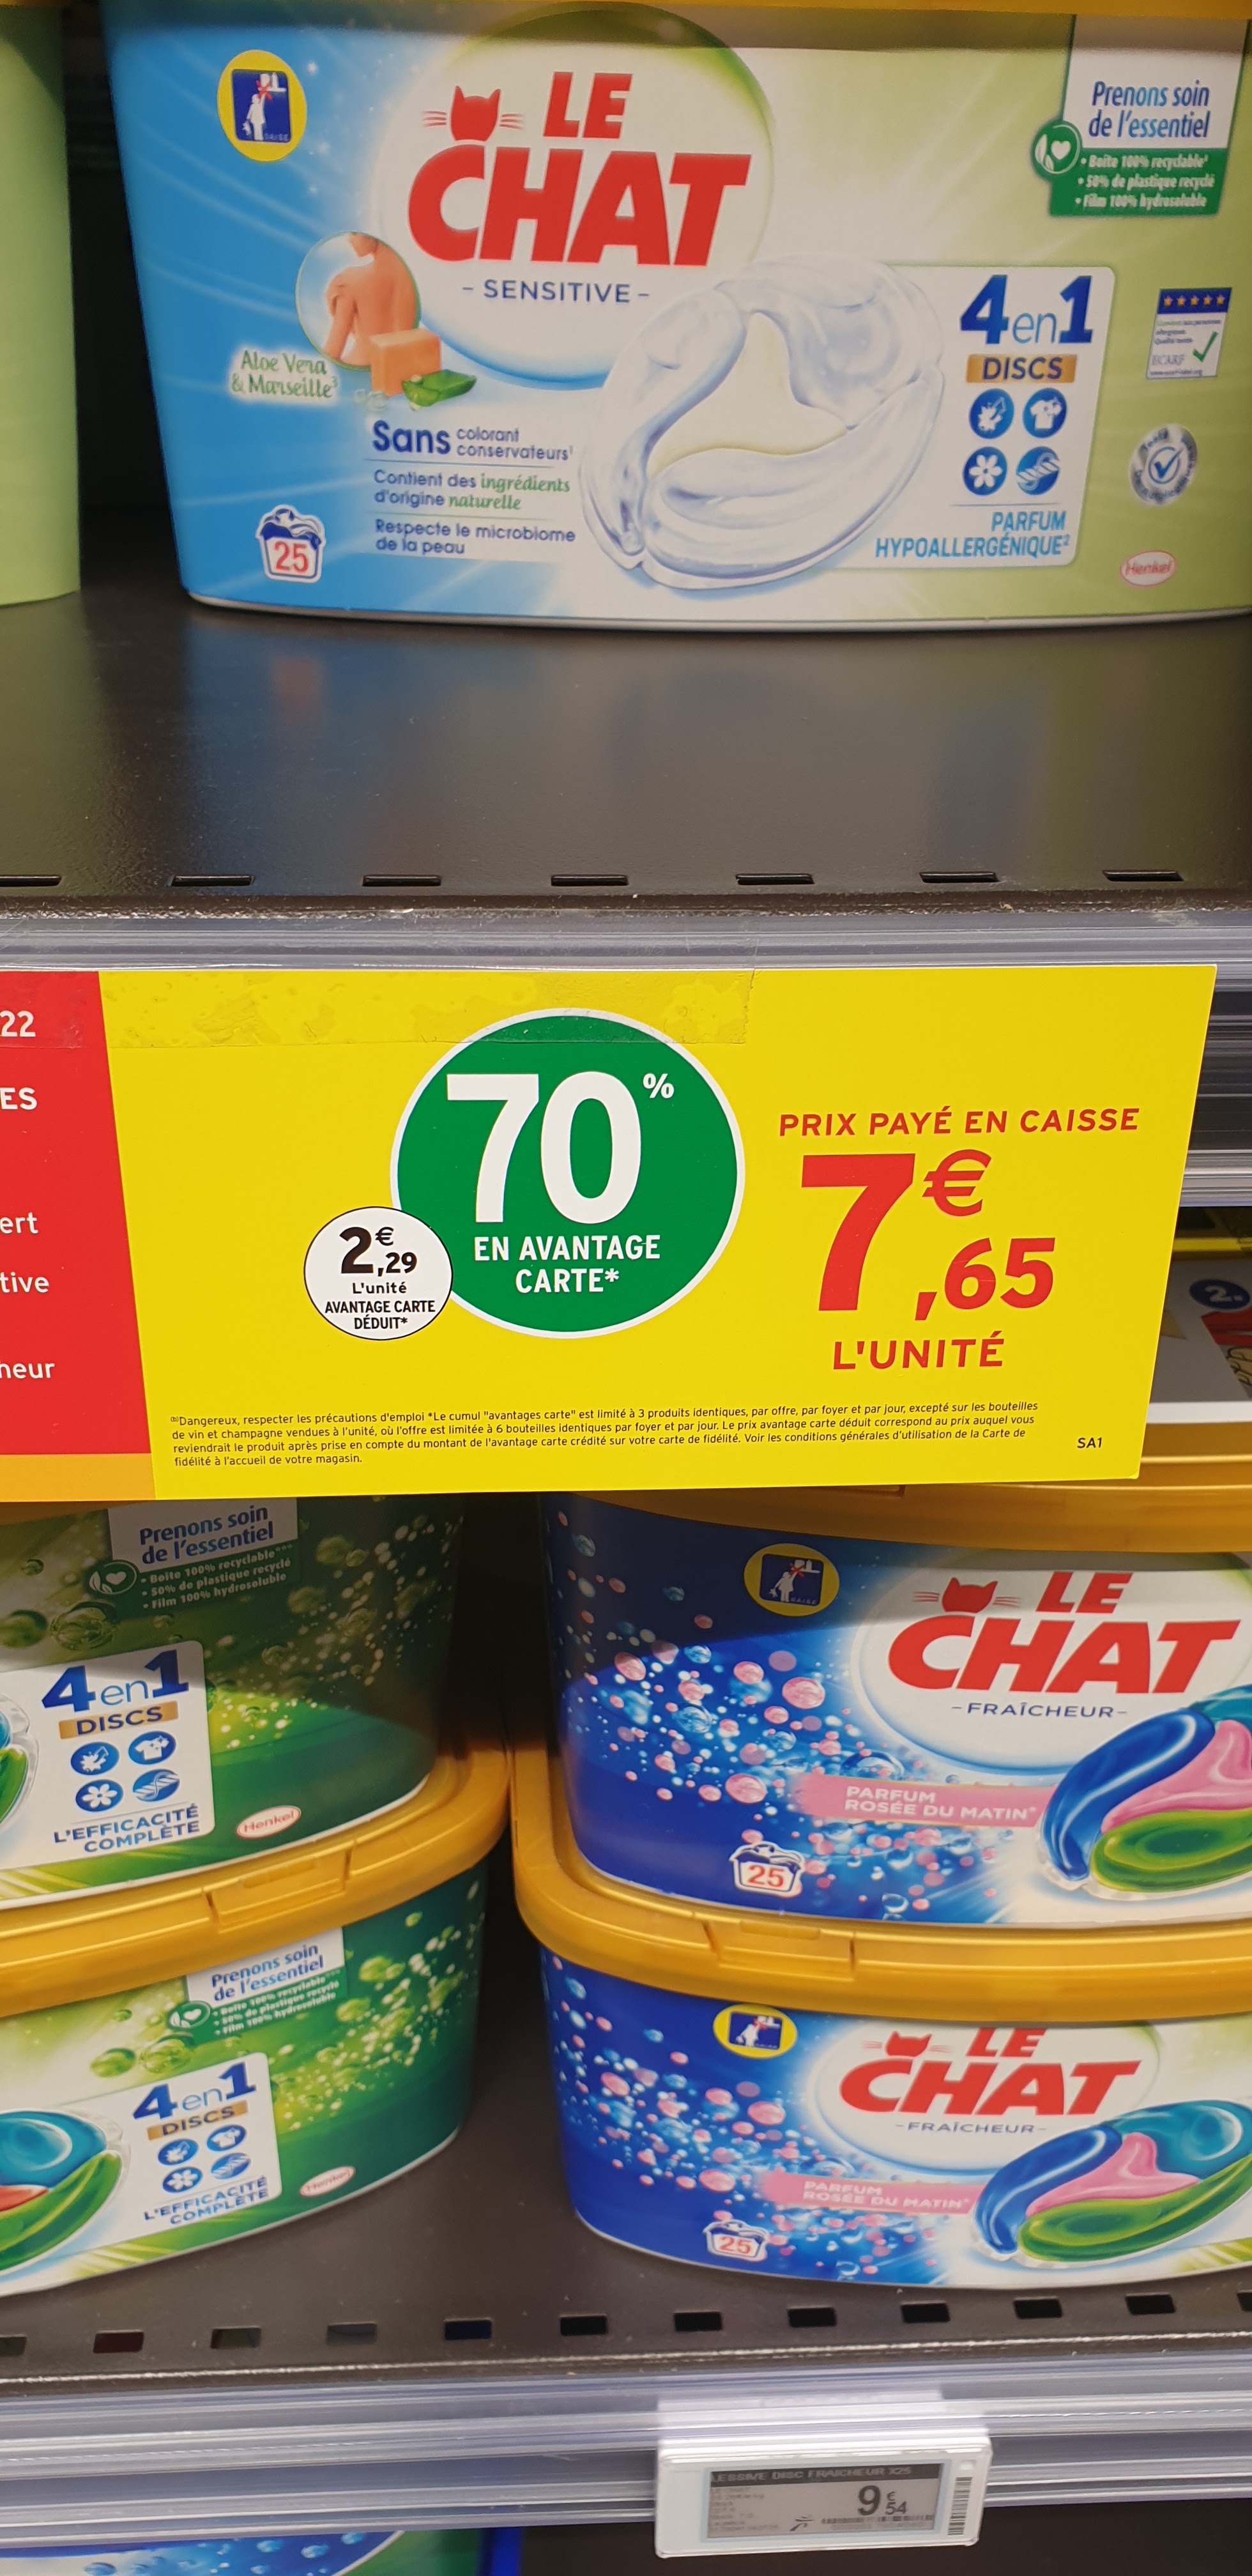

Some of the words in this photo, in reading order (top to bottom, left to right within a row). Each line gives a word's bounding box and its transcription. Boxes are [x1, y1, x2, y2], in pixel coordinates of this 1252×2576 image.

[543, 71, 633, 139] LE
[1092, 80, 1167, 107] Prenons
[1172, 79, 1210, 107] soin
[1088, 109, 1112, 137] de
[1116, 109, 1211, 138] l'essentiel
[408, 144, 752, 266] CHAT
[241, 350, 279, 372] Aloe
[282, 352, 327, 375] Vera
[982, 357, 1063, 380] DISCS
[372, 420, 451, 455] Sans
[457, 426, 519, 443] colorant
[374, 469, 443, 486] Contient
[447, 473, 477, 488] des
[480, 471, 570, 493] ingrédients
[374, 489, 445, 509] d'origine
[448, 494, 522, 510] naturelle
[375, 518, 451, 540] Respecte
[456, 523, 470, 537] le
[475, 525, 576, 542] microbiome
[991, 510, 1066, 532] PARFUM
[274, 541, 309, 572] 25
[376, 537, 397, 551] de
[402, 537, 417, 552] la
[422, 542, 465, 555] peau
[779, 1114, 857, 1137] PRIX
[869, 1105, 952, 1136] PAYÉ
[965, 1110, 1007, 1133] EN
[1019, 1108, 1140, 1133] CAISSE
[448, 1071, 641, 1224] 70
[475, 1237, 509, 1261] EN
[519, 1235, 660, 1261] AVANTAGE
[352, 1282, 407, 1295] L'unité
[324, 1300, 391, 1314] AVANTAGE
[394, 1299, 436, 1313] CARTE
[832, 1331, 1005, 1370] L'UNITÉ
[243, 1414, 294, 1426] respecter
[297, 1414, 312, 1423] les
[315, 1413, 378, 1425] précautions
[380, 1411, 424, 1423] d'emploi
[449, 1411, 480, 1421] cumul
[484, 1410, 541, 1422] "avantages
[544, 1409, 576, 1420] carte"
[579, 1409, 594, 1419] est
[597, 1408, 627, 1418] limité
[629, 1408, 635, 1418] à
[638, 1409, 645, 1418] 3
[648, 1407, 690, 1420] produits
[693, 1407, 749, 1418] identiques,
[751, 1408, 769, 1418] par
[771, 1406, 798, 1416] offre,
[802, 1407, 819, 1416] par
[821, 1405, 849, 1416] foyer
[851, 1404, 862, 1414] et
[864, 1406, 882, 1416] par
[883, 1404, 906, 1415] jour,
[909, 1402, 949, 1414] excepté
[971, 1402, 986, 1411] les
[988, 1401, 1038, 1411] bouteilles
[172, 1430, 185, 1439] de
[188, 1430, 204, 1439] vin
[207, 1429, 218, 1439] et
[221, 1429, 283, 1440] champagne
[286, 1427, 330, 1437] vendues
[333, 1426, 339, 1436] à
[342, 1425, 378, 1437] l'unité,
[381, 1425, 393, 1436] où
[397, 1425, 427, 1436] l'offre
[430, 1425, 445, 1435] est
[448, 1423, 484, 1434] limitée
[1077, 1437, 1103, 1449] SA1
[174, 1456, 211, 1466] fidélité
[215, 1455, 221, 1466] à
[224, 1455, 266, 1466] l'accueil
[269, 1455, 282, 1464] de
[284, 1455, 312, 1464] votre
[316, 1453, 362, 1465] magasin.
[139, 1517, 223, 1545] Prenons
[228, 1505, 268, 1528] soin
[142, 1545, 168, 1565] de
[174, 1521, 274, 1560] l'essentiel
[151, 1586, 176, 1597] 50%
[178, 1581, 194, 1592] de
[196, 1568, 250, 1590] plastique
[185, 1563, 216, 1577] 100%
[151, 1597, 177, 1609] Film
[181, 1590, 211, 1603] 100%
[213, 1572, 287, 1597] hydrosoluble
[1035, 1572, 1133, 1614] LE
[888, 1614, 1241, 1694] CHAT
[76, 1706, 163, 1735] DISCS
[844, 1799, 917, 1816] ROSÉE
[923, 1805, 953, 1818] DU
[846, 1786, 936, 1804] PARFUM
[54, 1803, 199, 1844] L'EFFICACITÉ
[244, 1810, 294, 1832] Henkel
[84, 1820, 200, 1852] COMPLÈTE
[747, 1864, 785, 1889] 25
[211, 1957, 280, 1988] Prenons
[284, 1944, 319, 1964] soin
[214, 1986, 235, 2001] de
[240, 1954, 324, 1994] l'essentiel
[966, 2028, 1046, 2057] LE
[839, 2058, 1141, 2116] CHAT
[162, 2106, 235, 2136] DISCS
[804, 2181, 882, 2196] PARFUM
[871, 2196, 896, 2206] DU
[718, 2235, 752, 2255] 25
